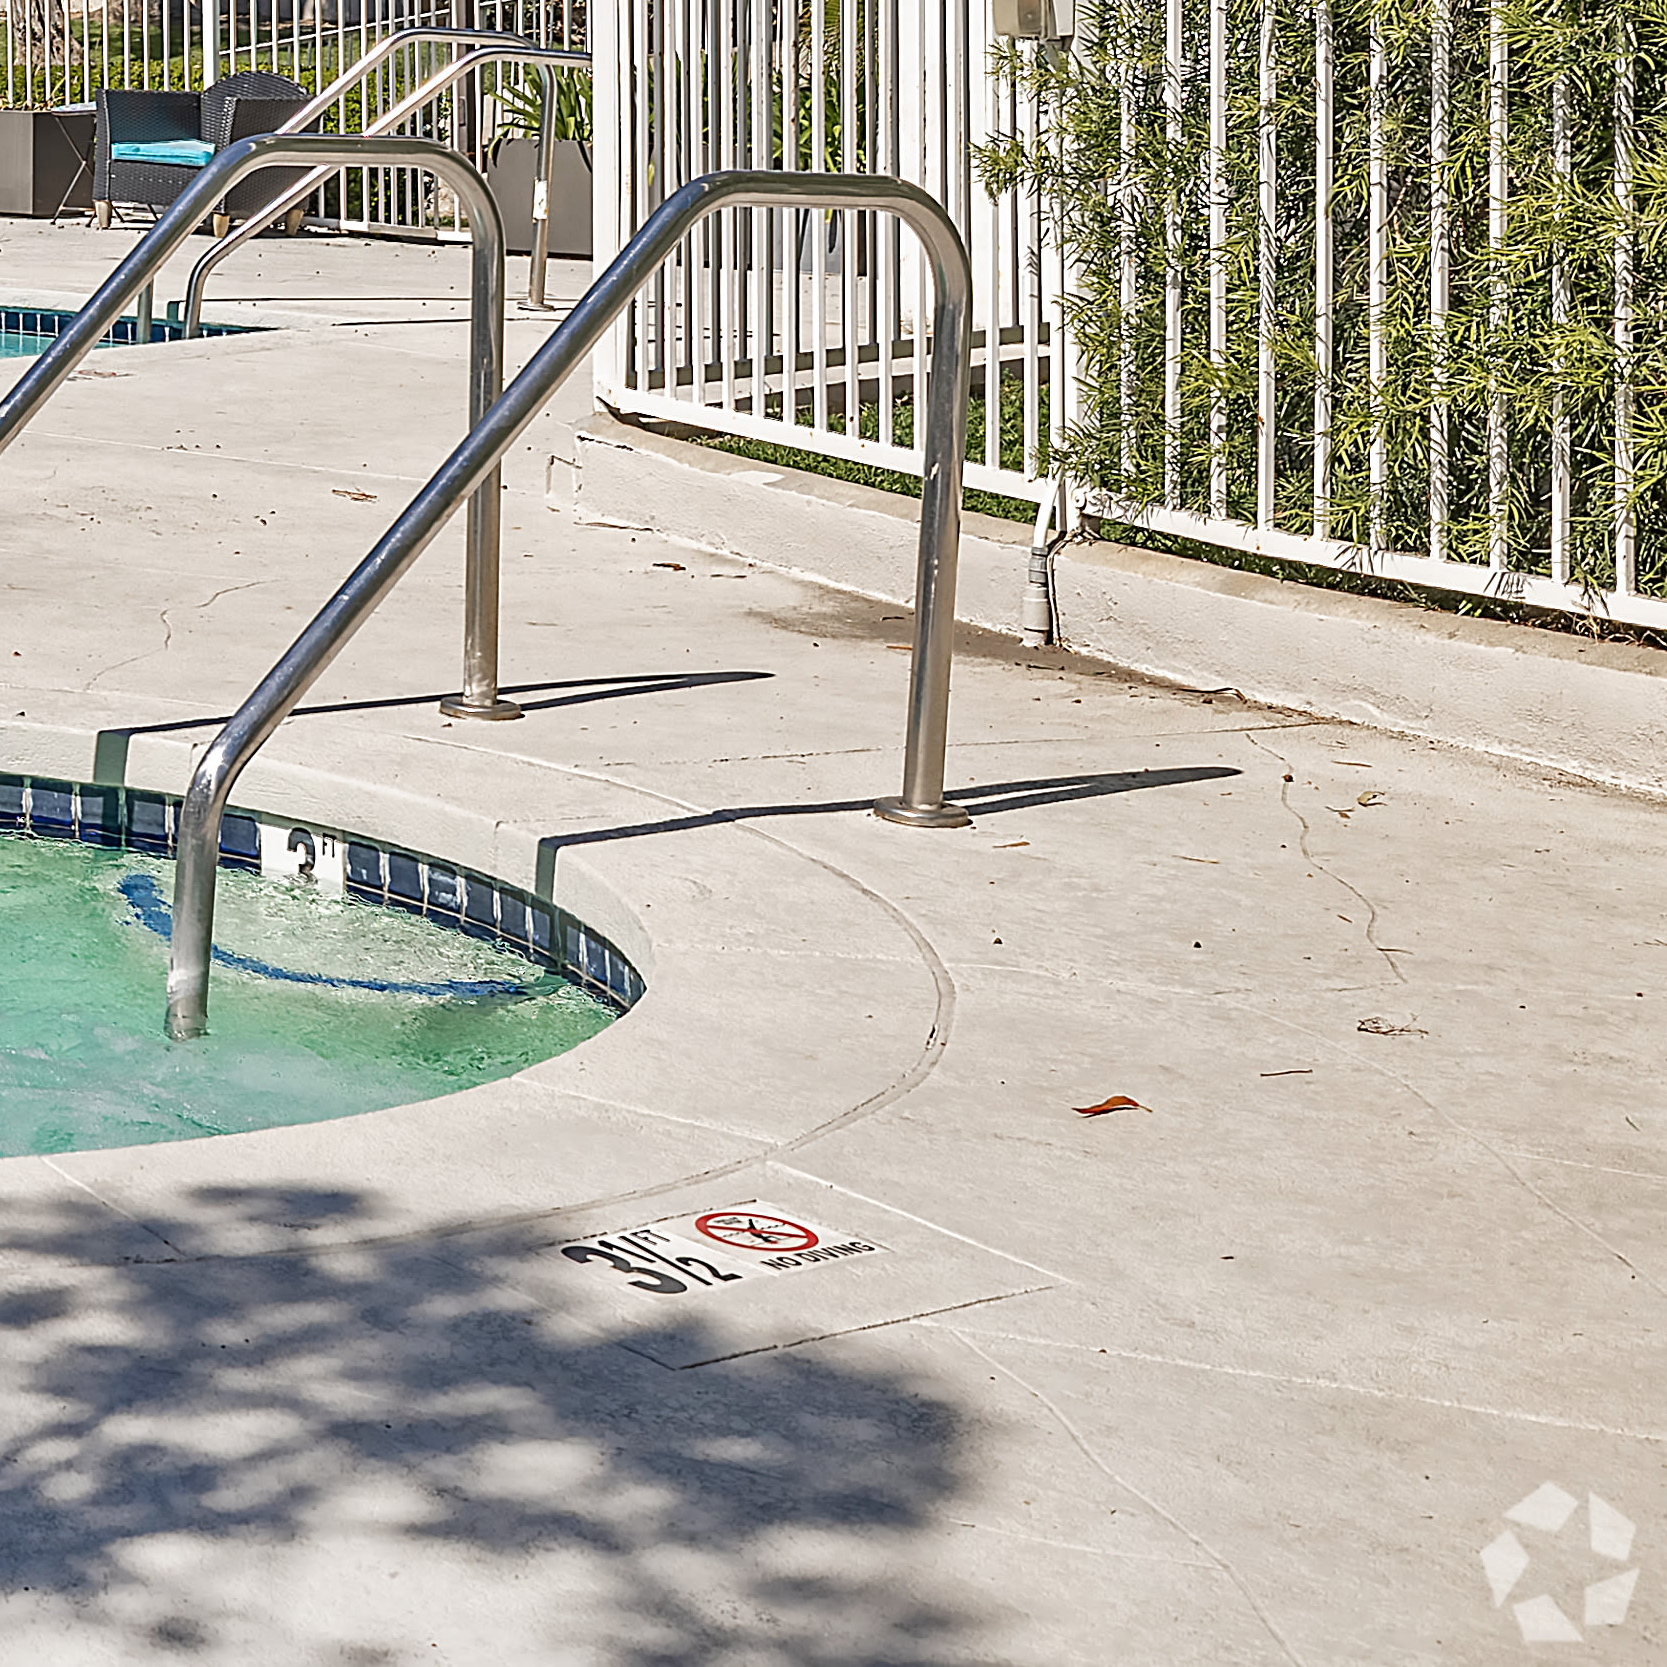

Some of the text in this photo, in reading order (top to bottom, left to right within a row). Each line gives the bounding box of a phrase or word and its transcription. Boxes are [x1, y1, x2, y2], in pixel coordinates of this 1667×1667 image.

[323, 833, 337, 858] FT
[631, 1229, 671, 1246] FT
[760, 1241, 875, 1271] NO DIVING
